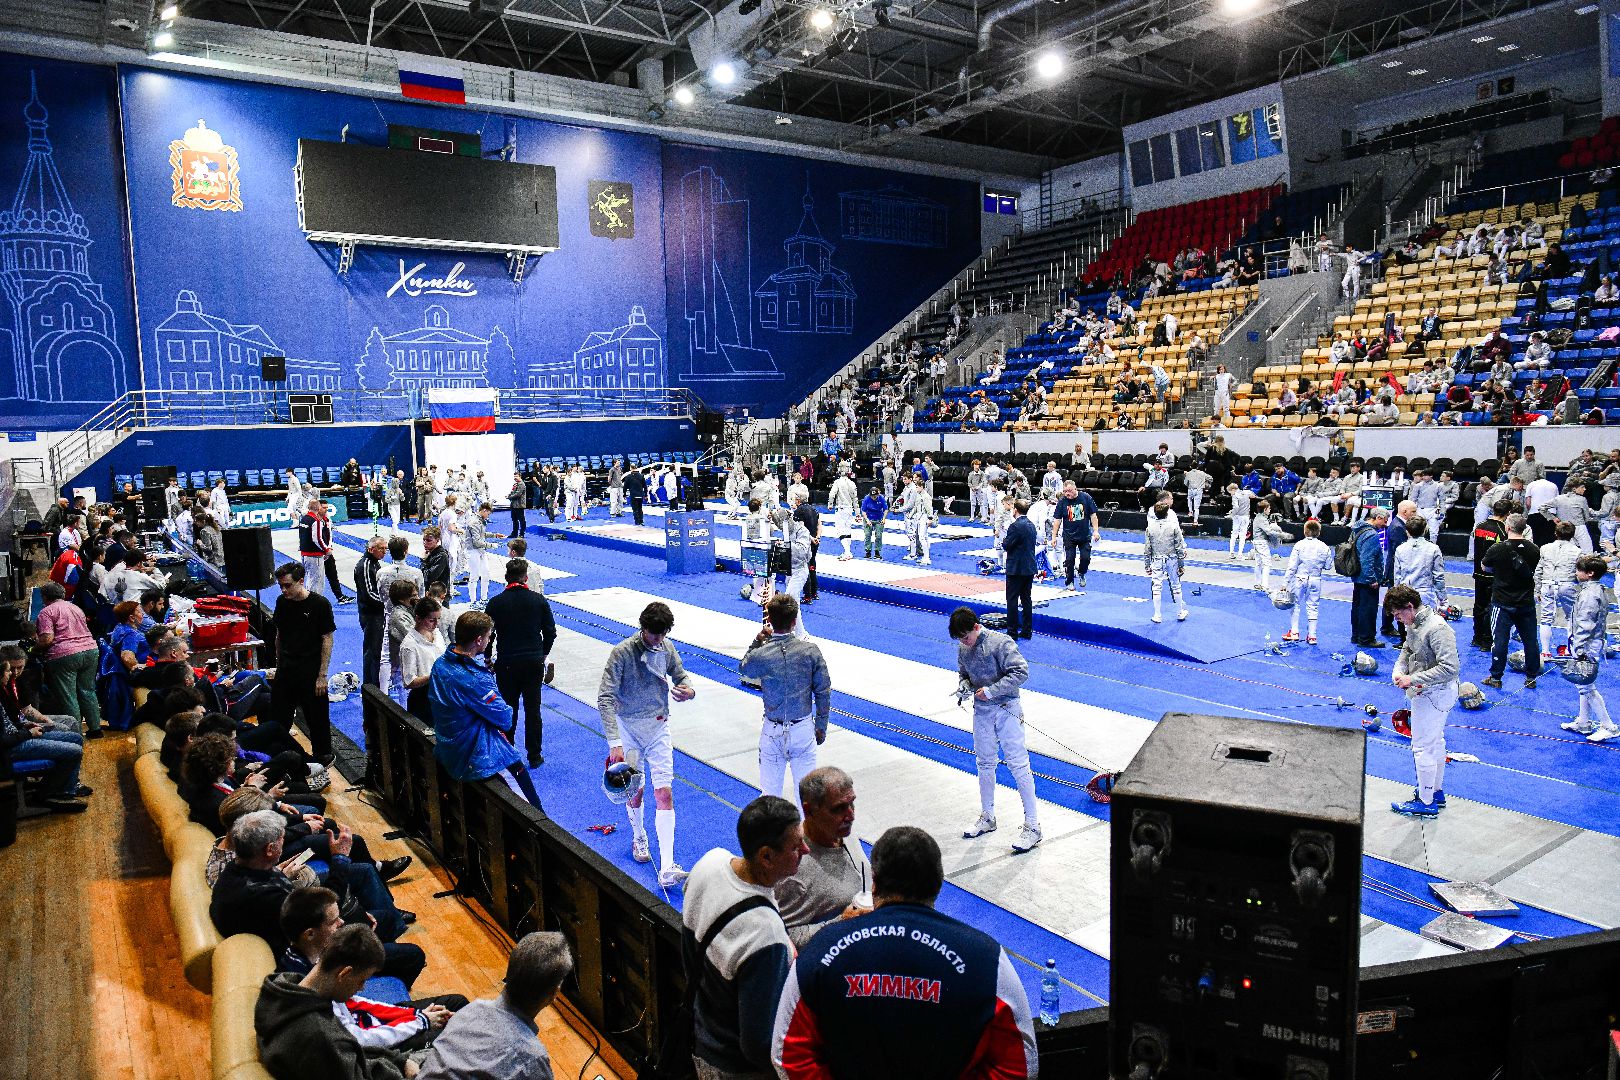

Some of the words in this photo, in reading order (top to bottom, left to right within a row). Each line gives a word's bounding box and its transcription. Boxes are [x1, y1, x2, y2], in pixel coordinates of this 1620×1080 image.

[386, 258, 478, 298] Химки
[820, 925, 906, 967] МОСКОВСКАЯ
[910, 929, 966, 974] ОБЛАСТЬ
[844, 973, 942, 1003] ХИМКИ
[1262, 1023, 1339, 1051] MID-HIGH
